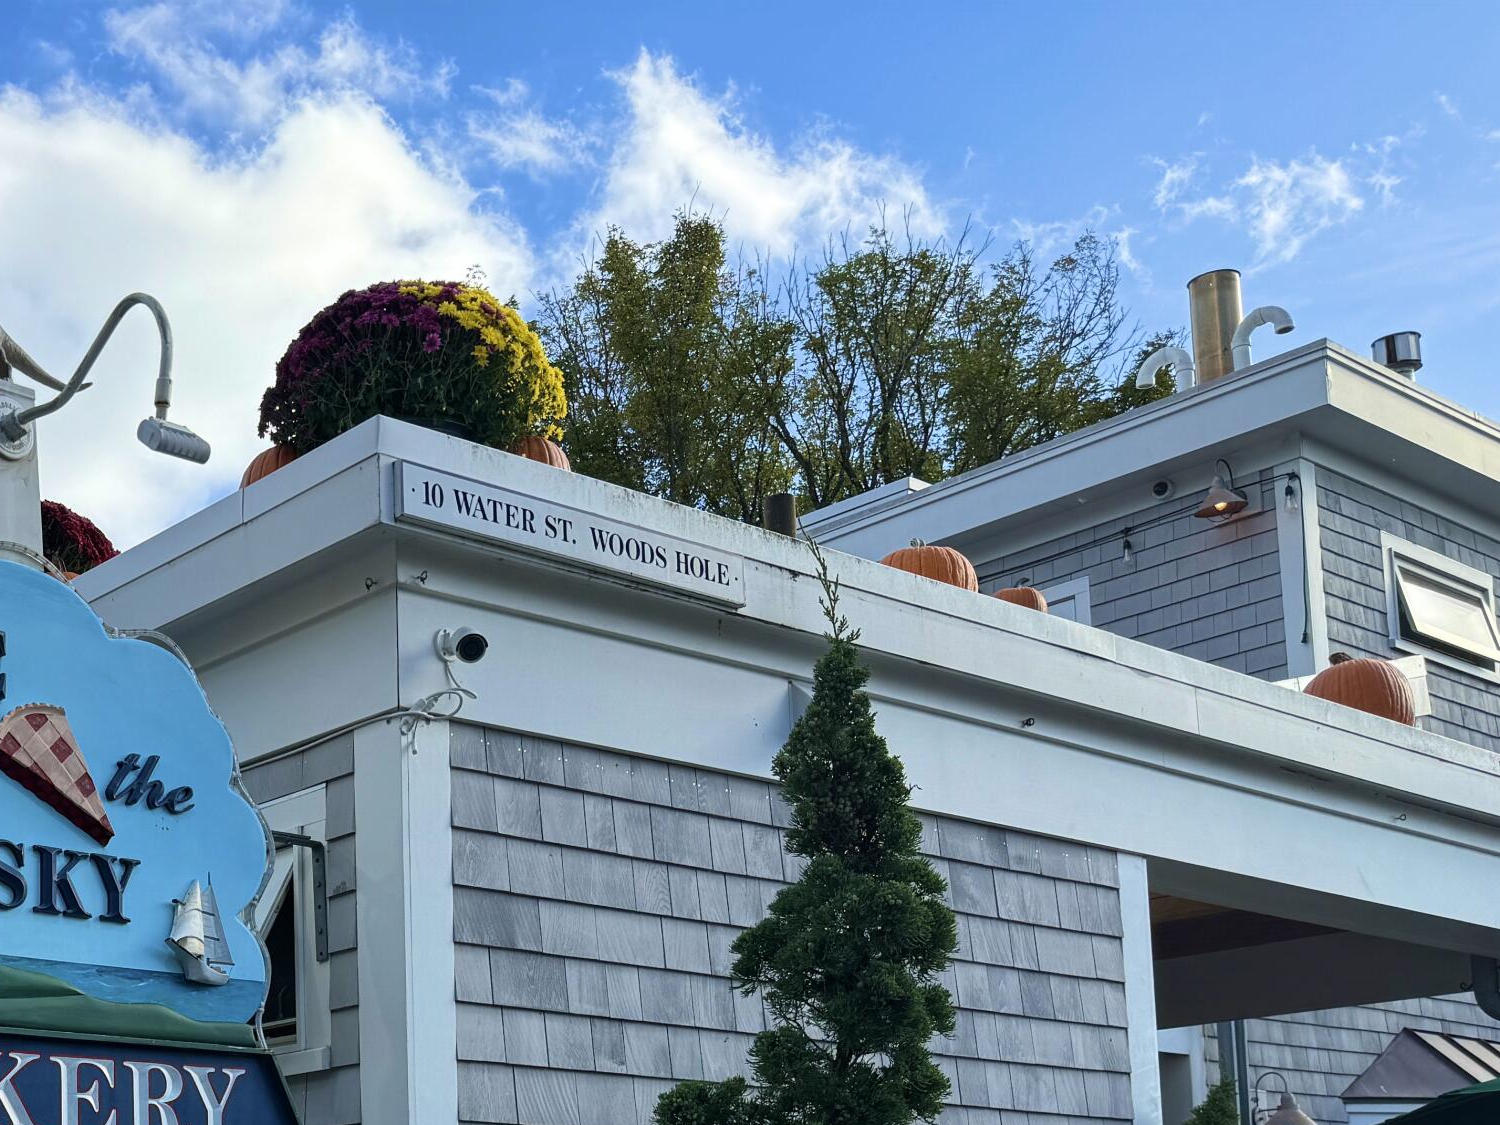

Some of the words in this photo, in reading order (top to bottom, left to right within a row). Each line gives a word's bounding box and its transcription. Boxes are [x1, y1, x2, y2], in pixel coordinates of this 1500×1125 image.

[422, 480, 445, 509] 10
[453, 488, 536, 534] WATER
[544, 515, 577, 545] ST.
[591, 527, 668, 569] WOODS
[675, 550, 731, 587] HOLE
[105, 751, 196, 815] the
